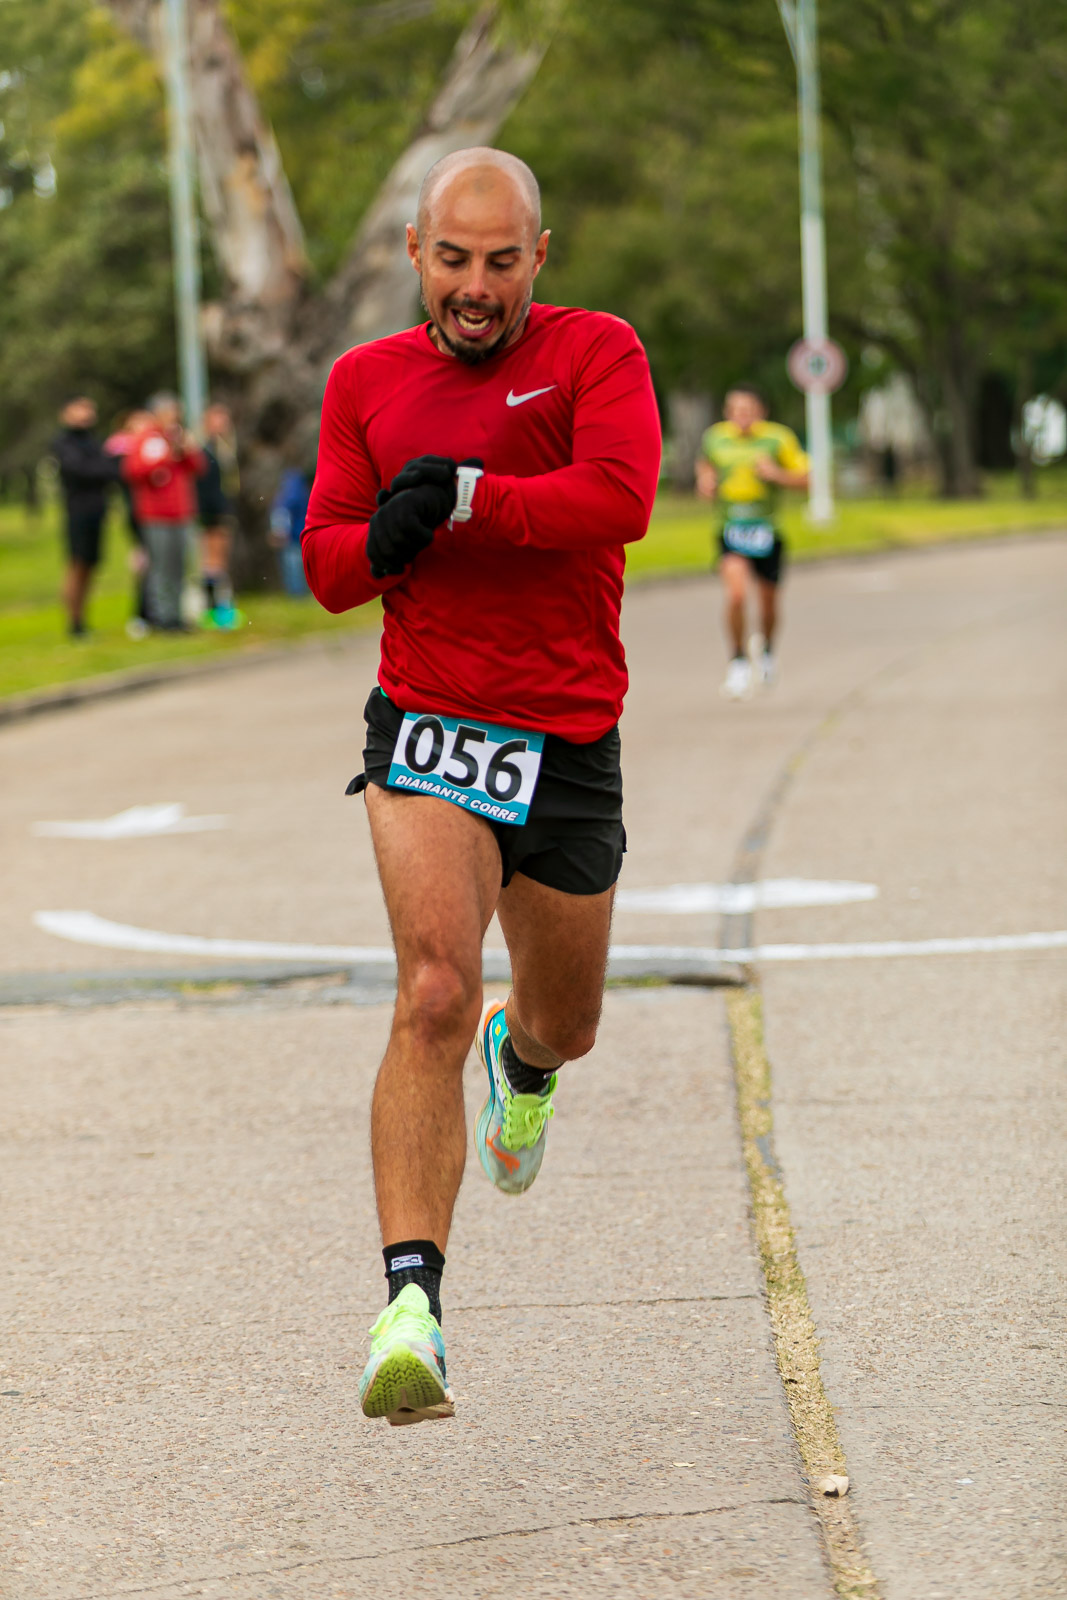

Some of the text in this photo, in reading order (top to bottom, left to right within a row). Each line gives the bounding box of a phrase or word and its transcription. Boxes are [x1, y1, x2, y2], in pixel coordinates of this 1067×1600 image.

[405, 714, 528, 803] 056
[395, 775, 519, 822] DIAMANTE CORRE
